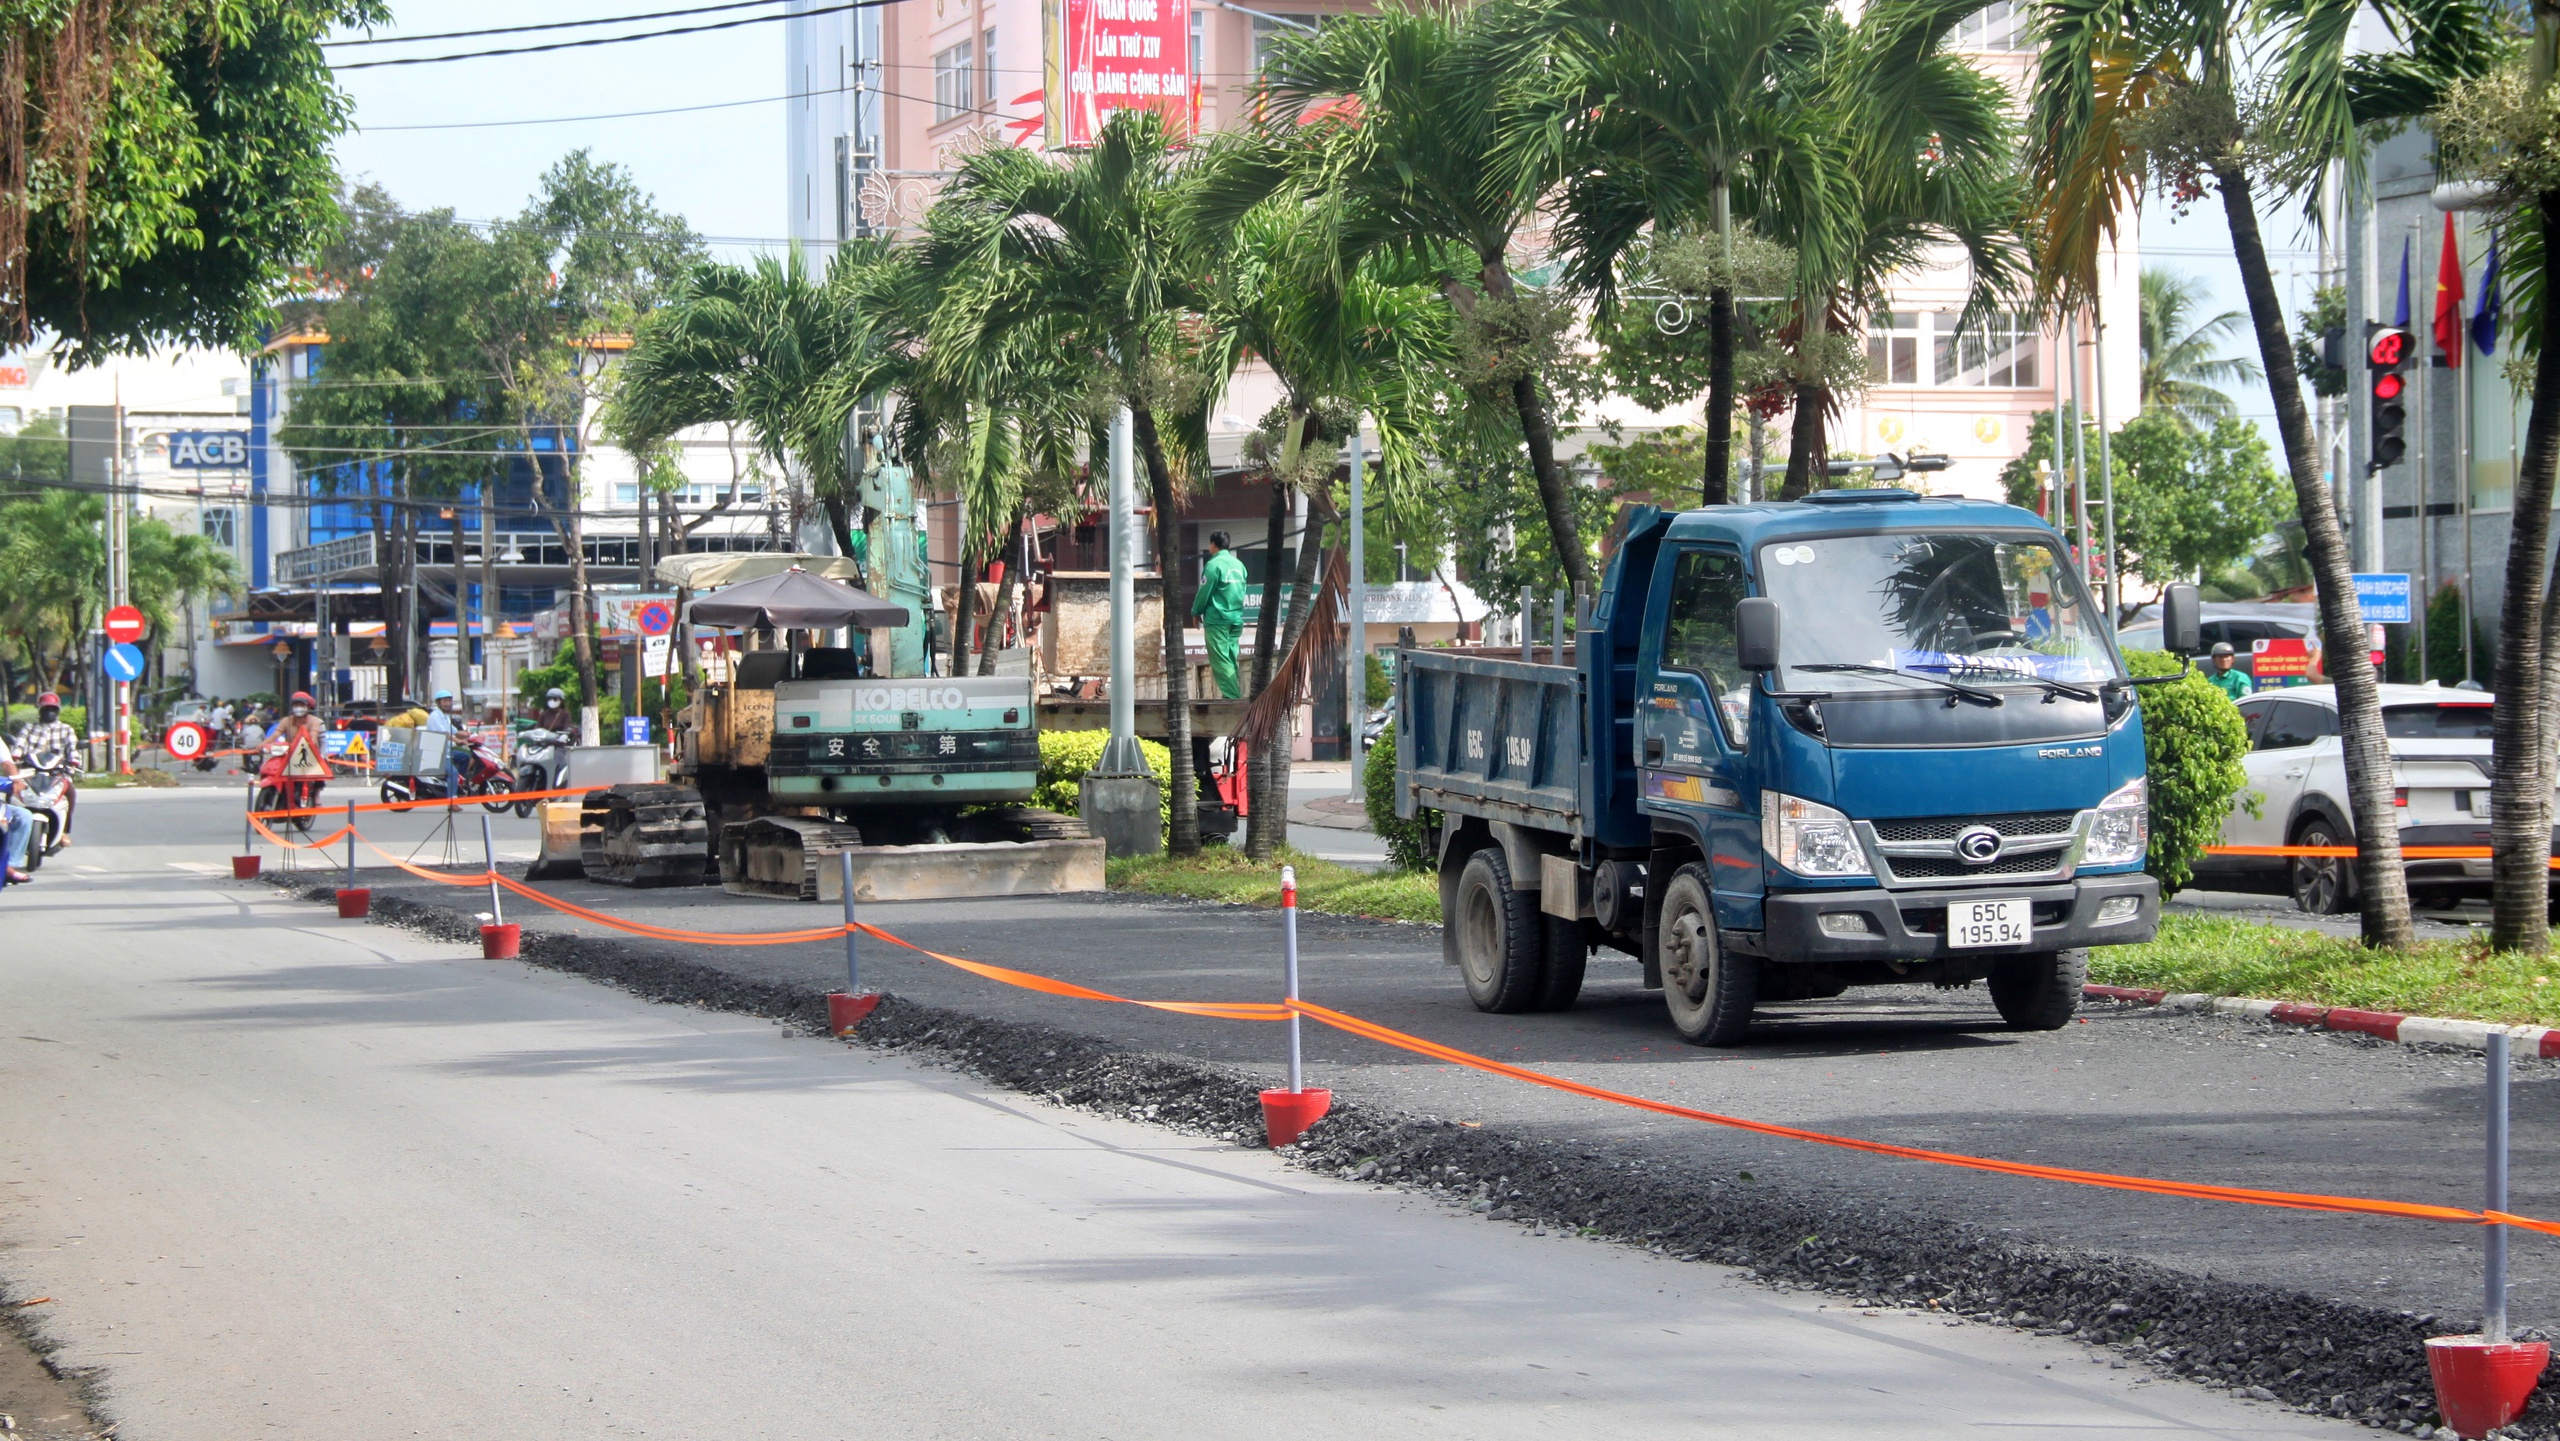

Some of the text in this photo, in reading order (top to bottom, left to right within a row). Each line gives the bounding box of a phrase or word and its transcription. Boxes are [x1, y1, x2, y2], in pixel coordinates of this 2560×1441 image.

[1119, 32, 1141, 58] THỨ
[1143, 36, 1161, 58] XIV
[1071, 64, 1185, 99] CỦA ĐẢNG CỘNG SẢN
[2372, 334, 2402, 364] 22
[174, 435, 246, 465] ACB
[855, 687, 963, 711] KOBELCO
[177, 735, 194, 748] 40
[1467, 729, 1484, 759] 65C
[2038, 746, 2102, 759] FORLAND
[1972, 903, 2008, 922] 65C
[1960, 923, 2022, 944] 195.94
